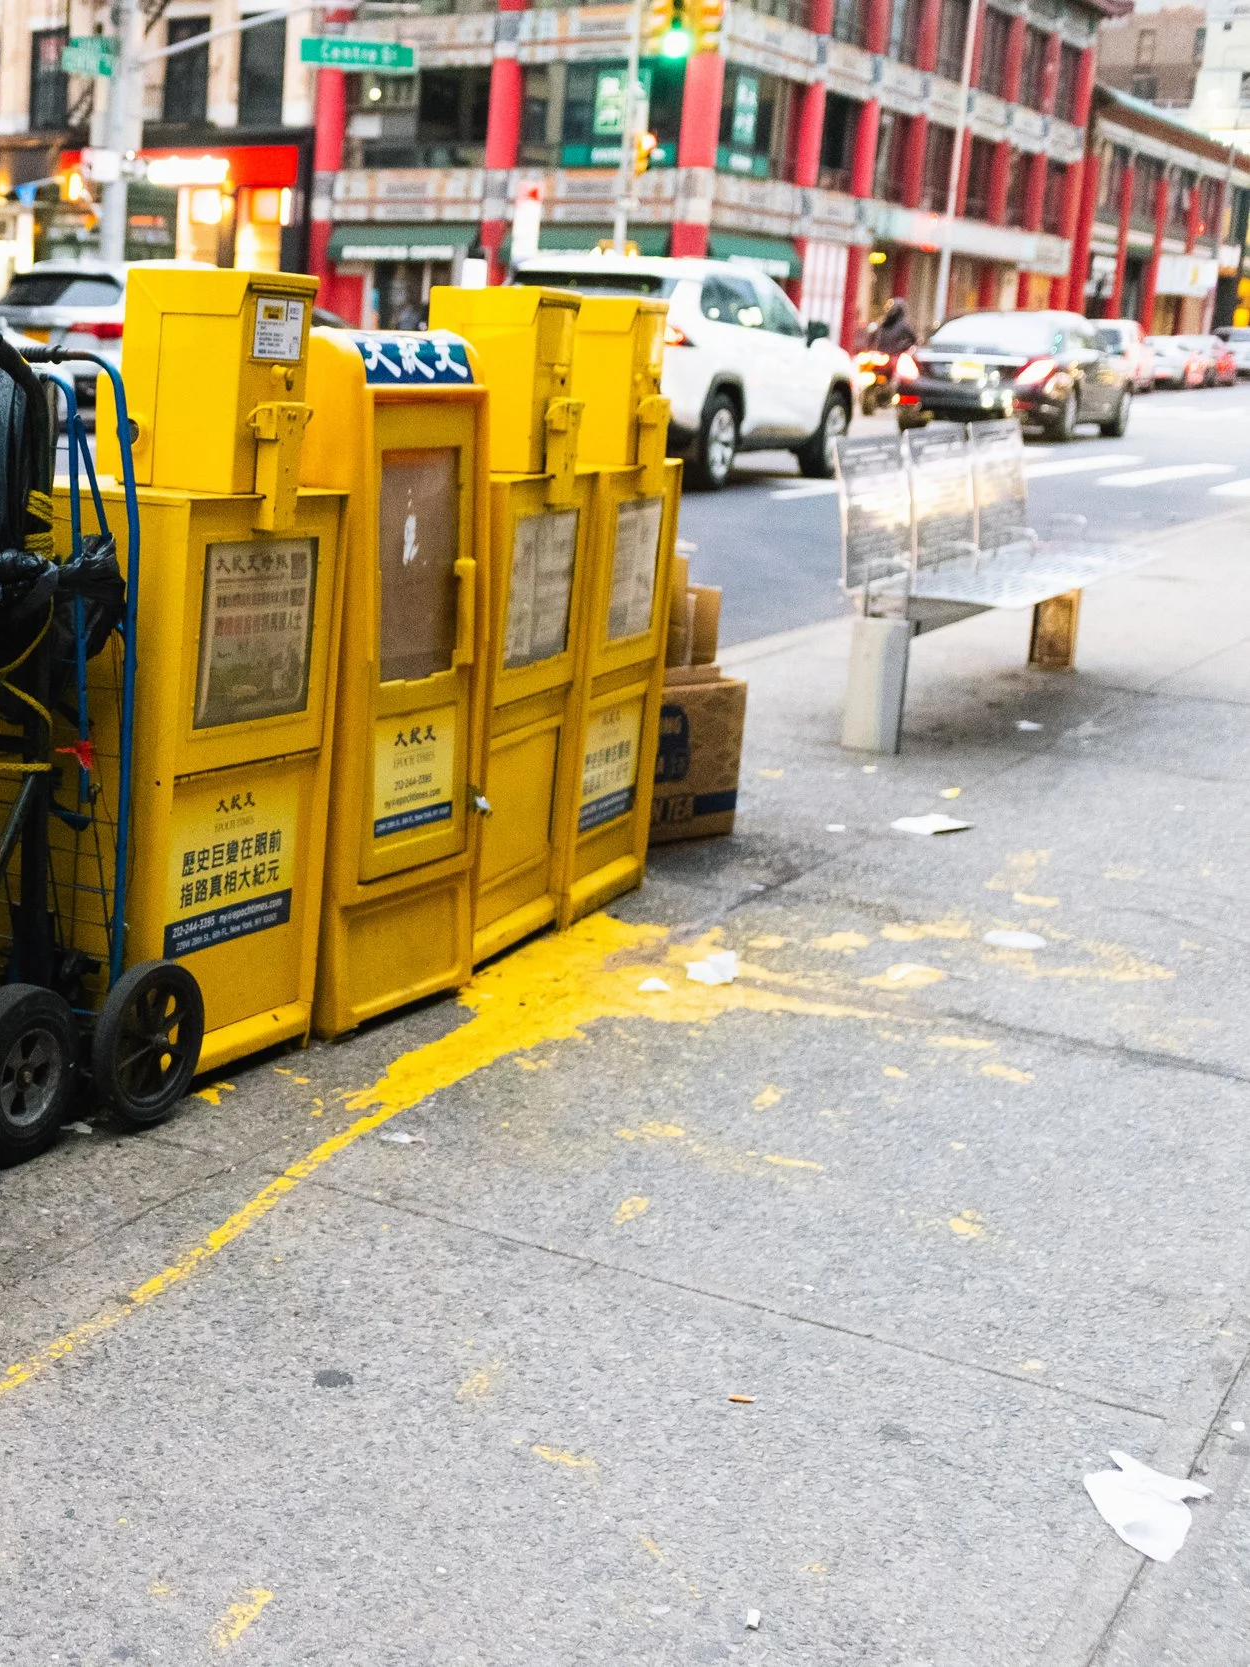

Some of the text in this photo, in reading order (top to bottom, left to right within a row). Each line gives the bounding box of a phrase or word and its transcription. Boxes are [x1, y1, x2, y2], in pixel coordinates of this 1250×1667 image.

[181, 828, 282, 878] 歷史巨變在眼前
[180, 858, 281, 909] 指路真相大紀元
